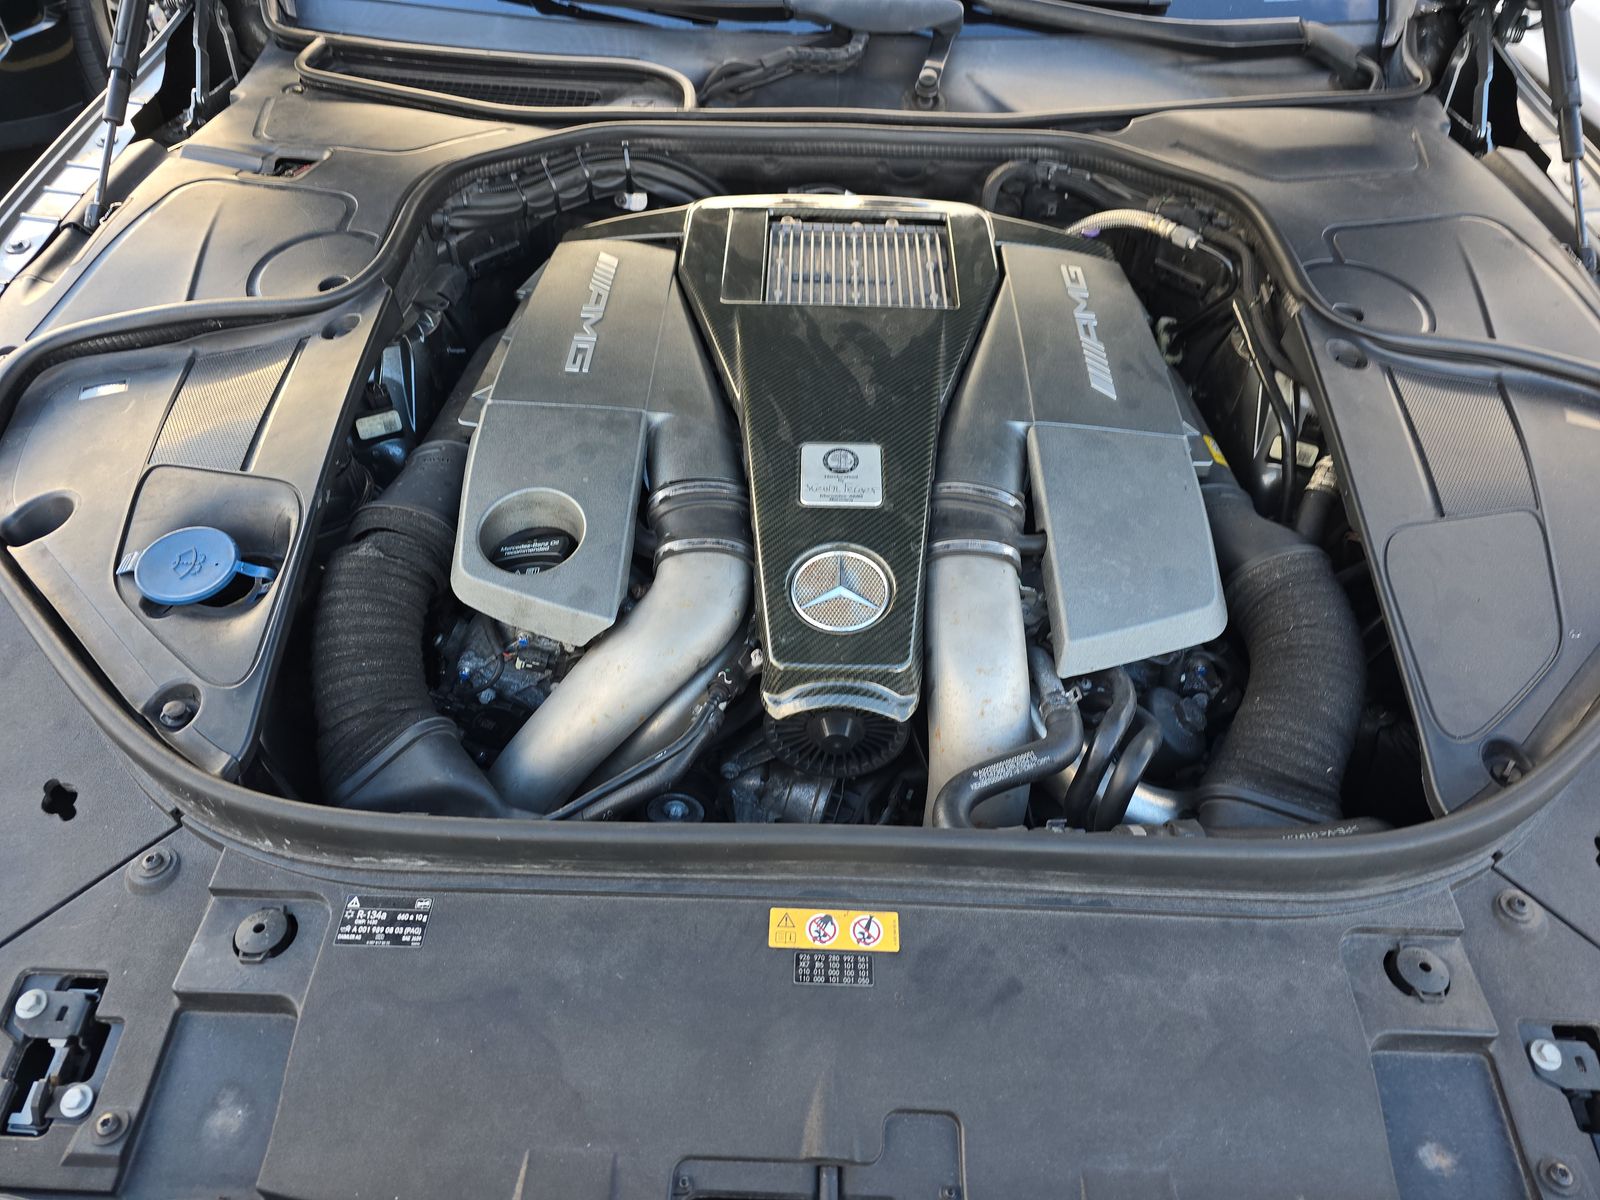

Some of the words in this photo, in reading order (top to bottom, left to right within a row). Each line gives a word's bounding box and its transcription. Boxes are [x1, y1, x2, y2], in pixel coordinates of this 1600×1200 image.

[564, 287, 610, 373] AMG
[356, 909, 387, 921] R-134a
[415, 913, 422, 921] 10
[844, 969, 855, 977] 100
